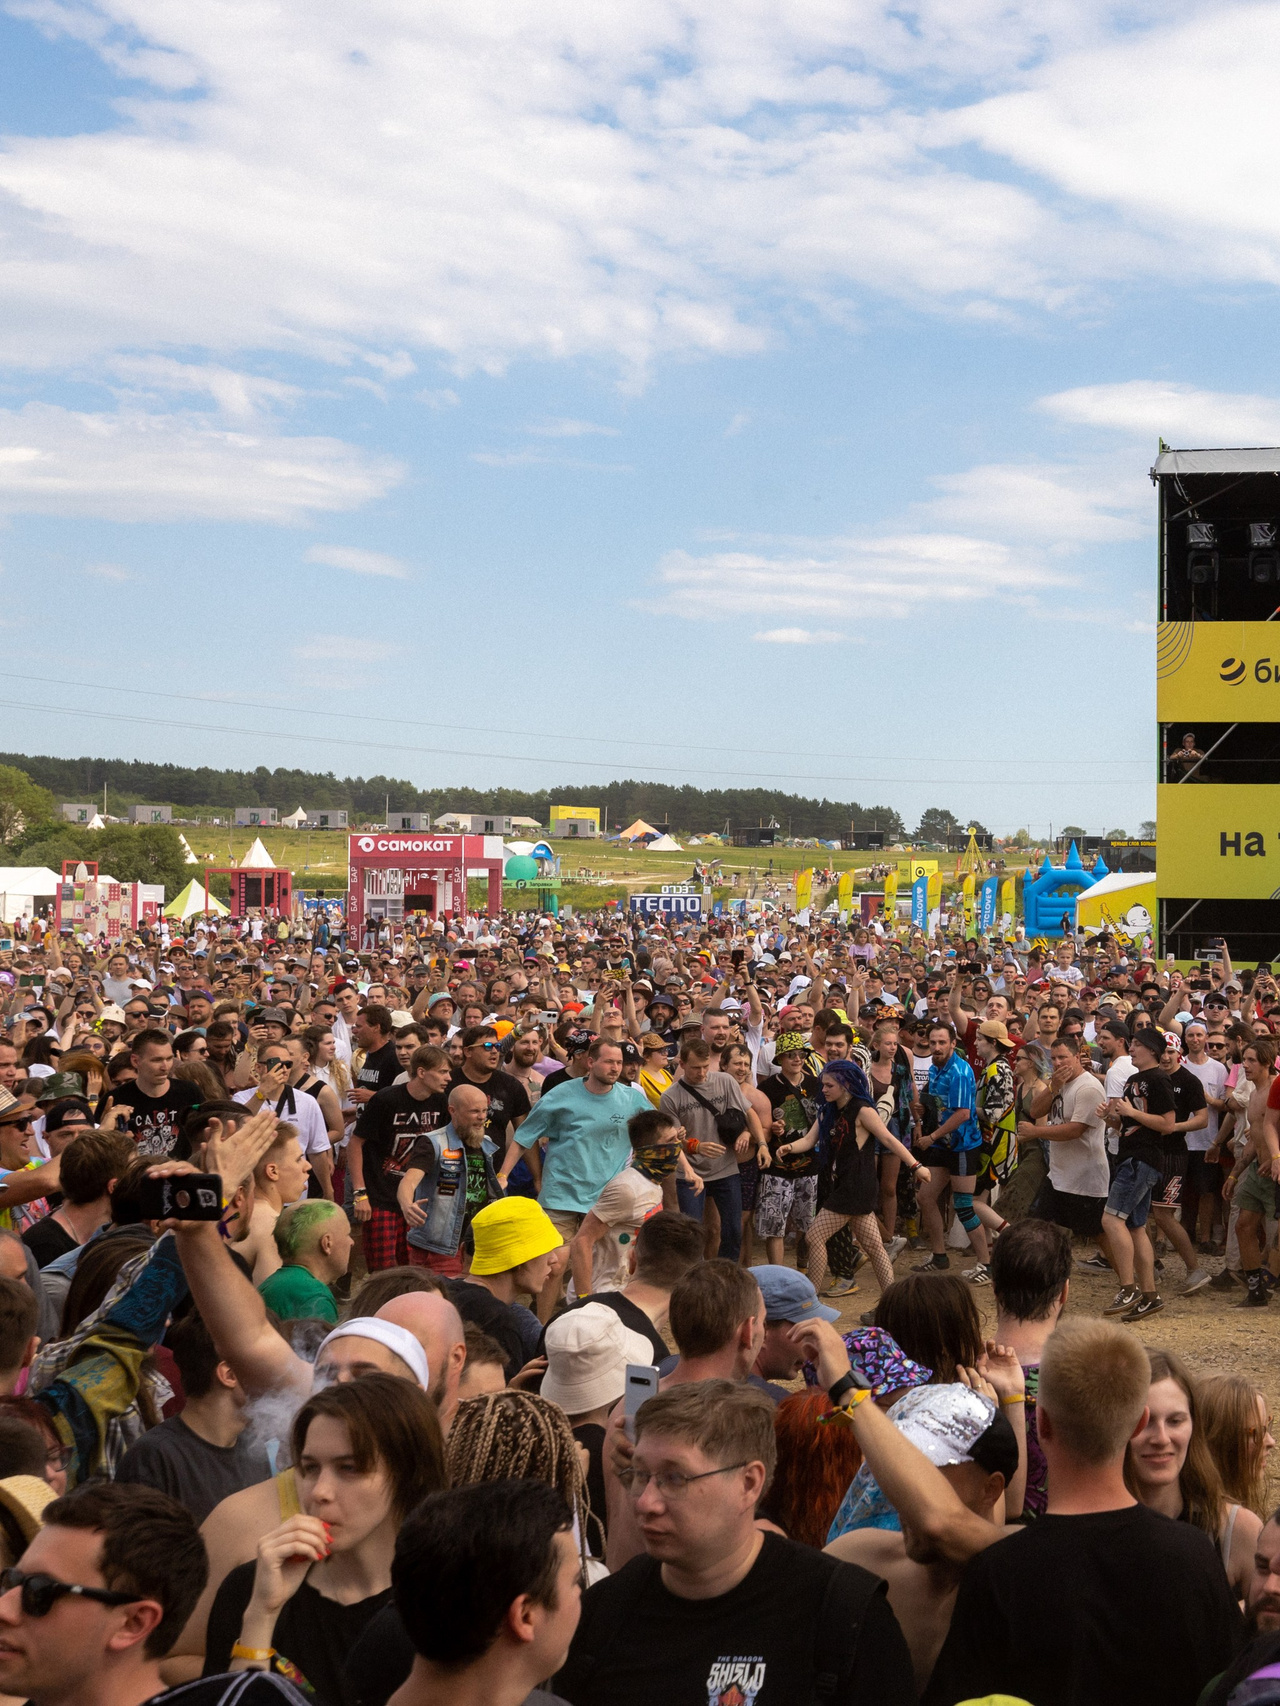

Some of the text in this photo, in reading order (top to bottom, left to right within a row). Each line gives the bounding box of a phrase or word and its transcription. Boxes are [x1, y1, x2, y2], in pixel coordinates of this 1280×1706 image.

[377, 840, 454, 852] самокат
[1219, 831, 1266, 857] на
[454, 866, 462, 883] БАР
[454, 895, 462, 912] БАР
[631, 897, 700, 912] TECNO
